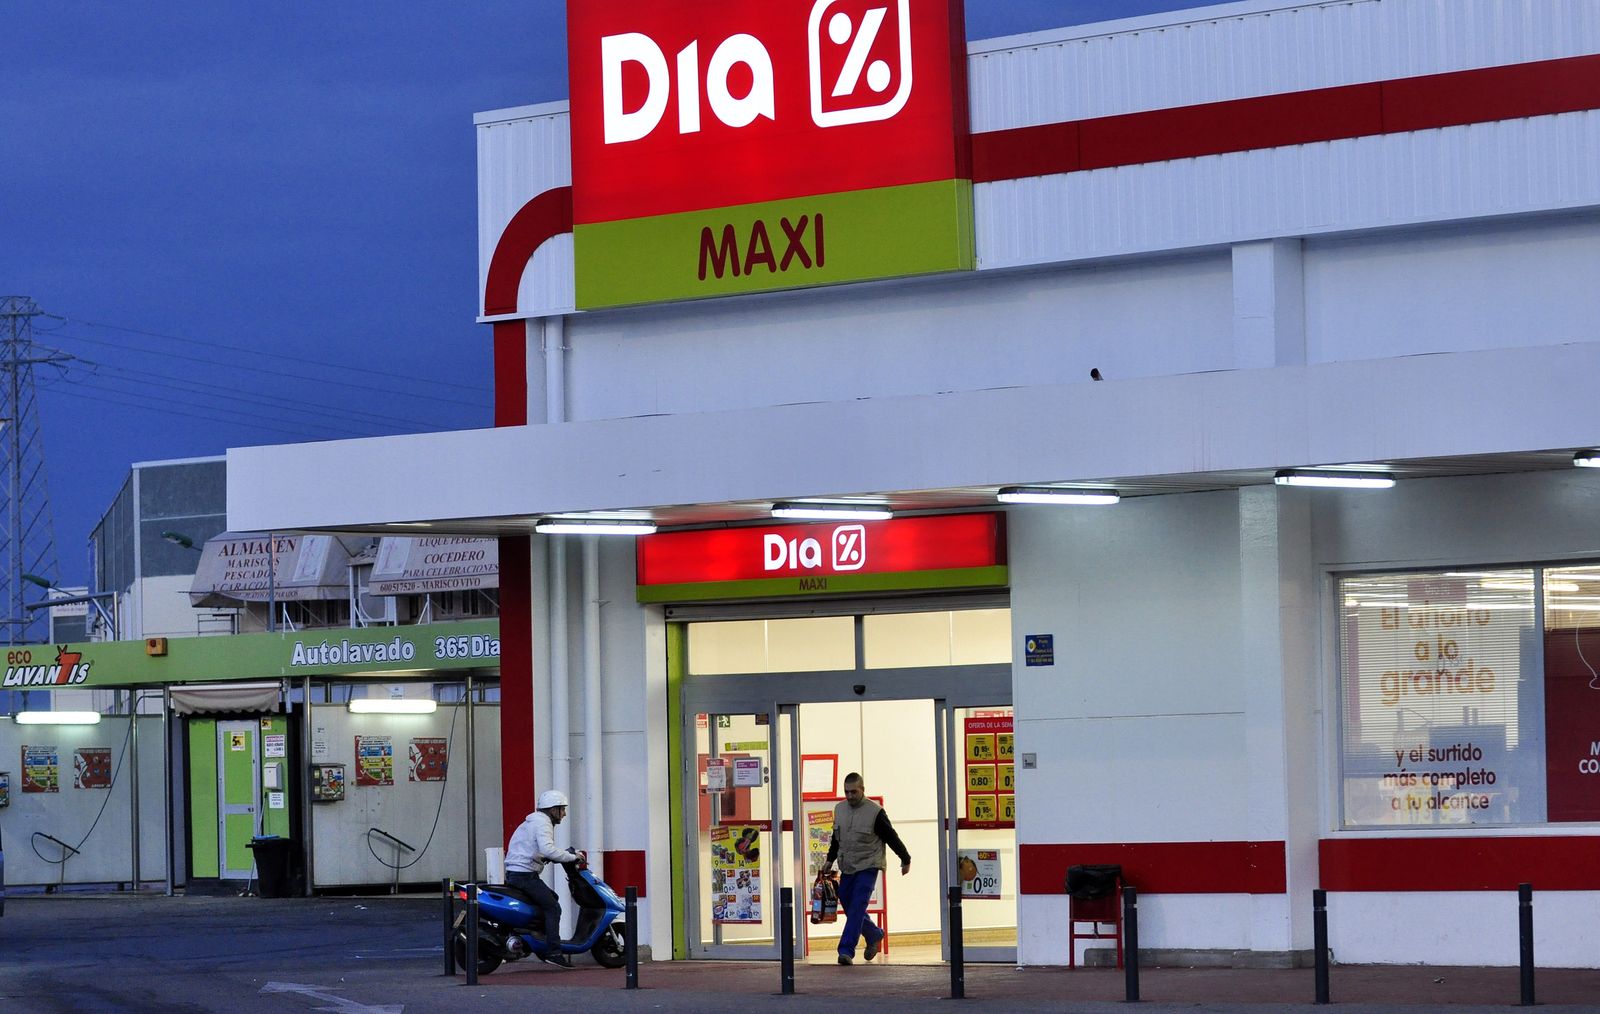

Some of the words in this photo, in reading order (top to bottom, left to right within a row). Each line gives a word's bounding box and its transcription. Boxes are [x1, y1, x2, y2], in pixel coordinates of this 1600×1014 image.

[698, 213, 824, 281] MAXI
[424, 550, 485, 564] COCEDERO
[402, 568, 425, 578] PARA
[426, 563, 499, 577] CELEBRACIONES
[217, 581, 281, 592] CARACOLS
[422, 579, 459, 589] MARISCO
[460, 577, 481, 588] VIVO
[799, 578, 828, 591] MAXI
[291, 637, 415, 666] Autolavado
[435, 636, 469, 659] 365
[1415, 640, 1430, 661] a
[1437, 633, 1459, 660] lo
[7, 650, 32, 665] eco
[1380, 657, 1496, 706] grande
[1395, 749, 1405, 767] y
[1409, 744, 1422, 762] el
[1428, 743, 1482, 762] surtido
[1579, 759, 1600, 774] CO
[1383, 768, 1417, 787] más
[1422, 767, 1496, 790] completo
[1391, 797, 1401, 810] a
[1407, 793, 1422, 810] tu
[1427, 792, 1490, 810] alcance
